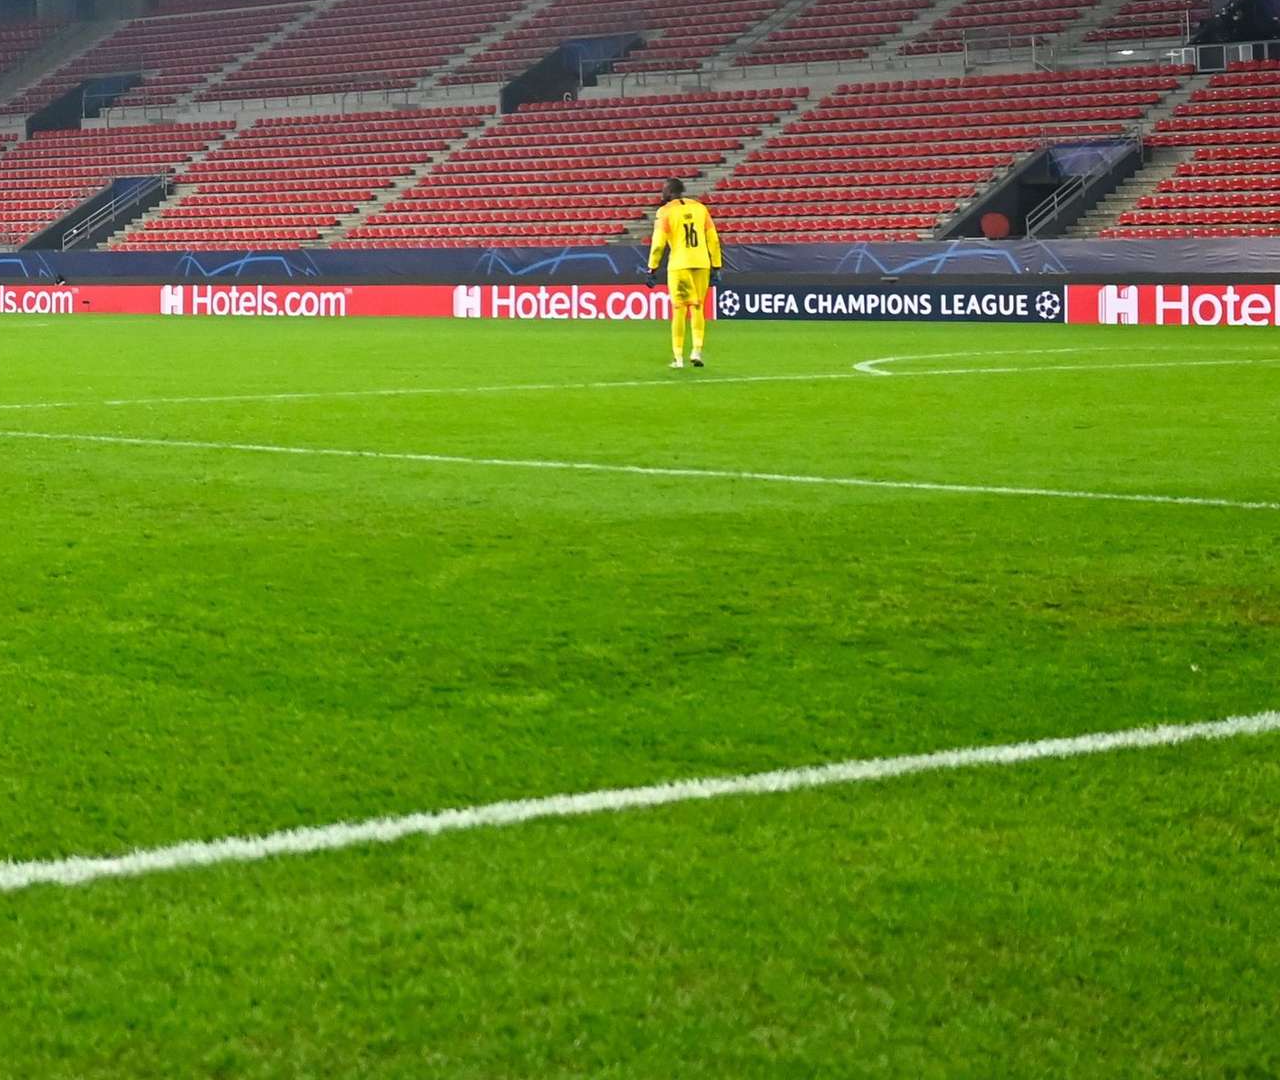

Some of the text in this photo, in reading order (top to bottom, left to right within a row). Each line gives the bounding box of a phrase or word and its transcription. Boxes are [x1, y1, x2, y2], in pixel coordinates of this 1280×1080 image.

[683, 223, 698, 248] 16
[744, 293, 1029, 316] UEFA CHAMPIONS LEAGUE
